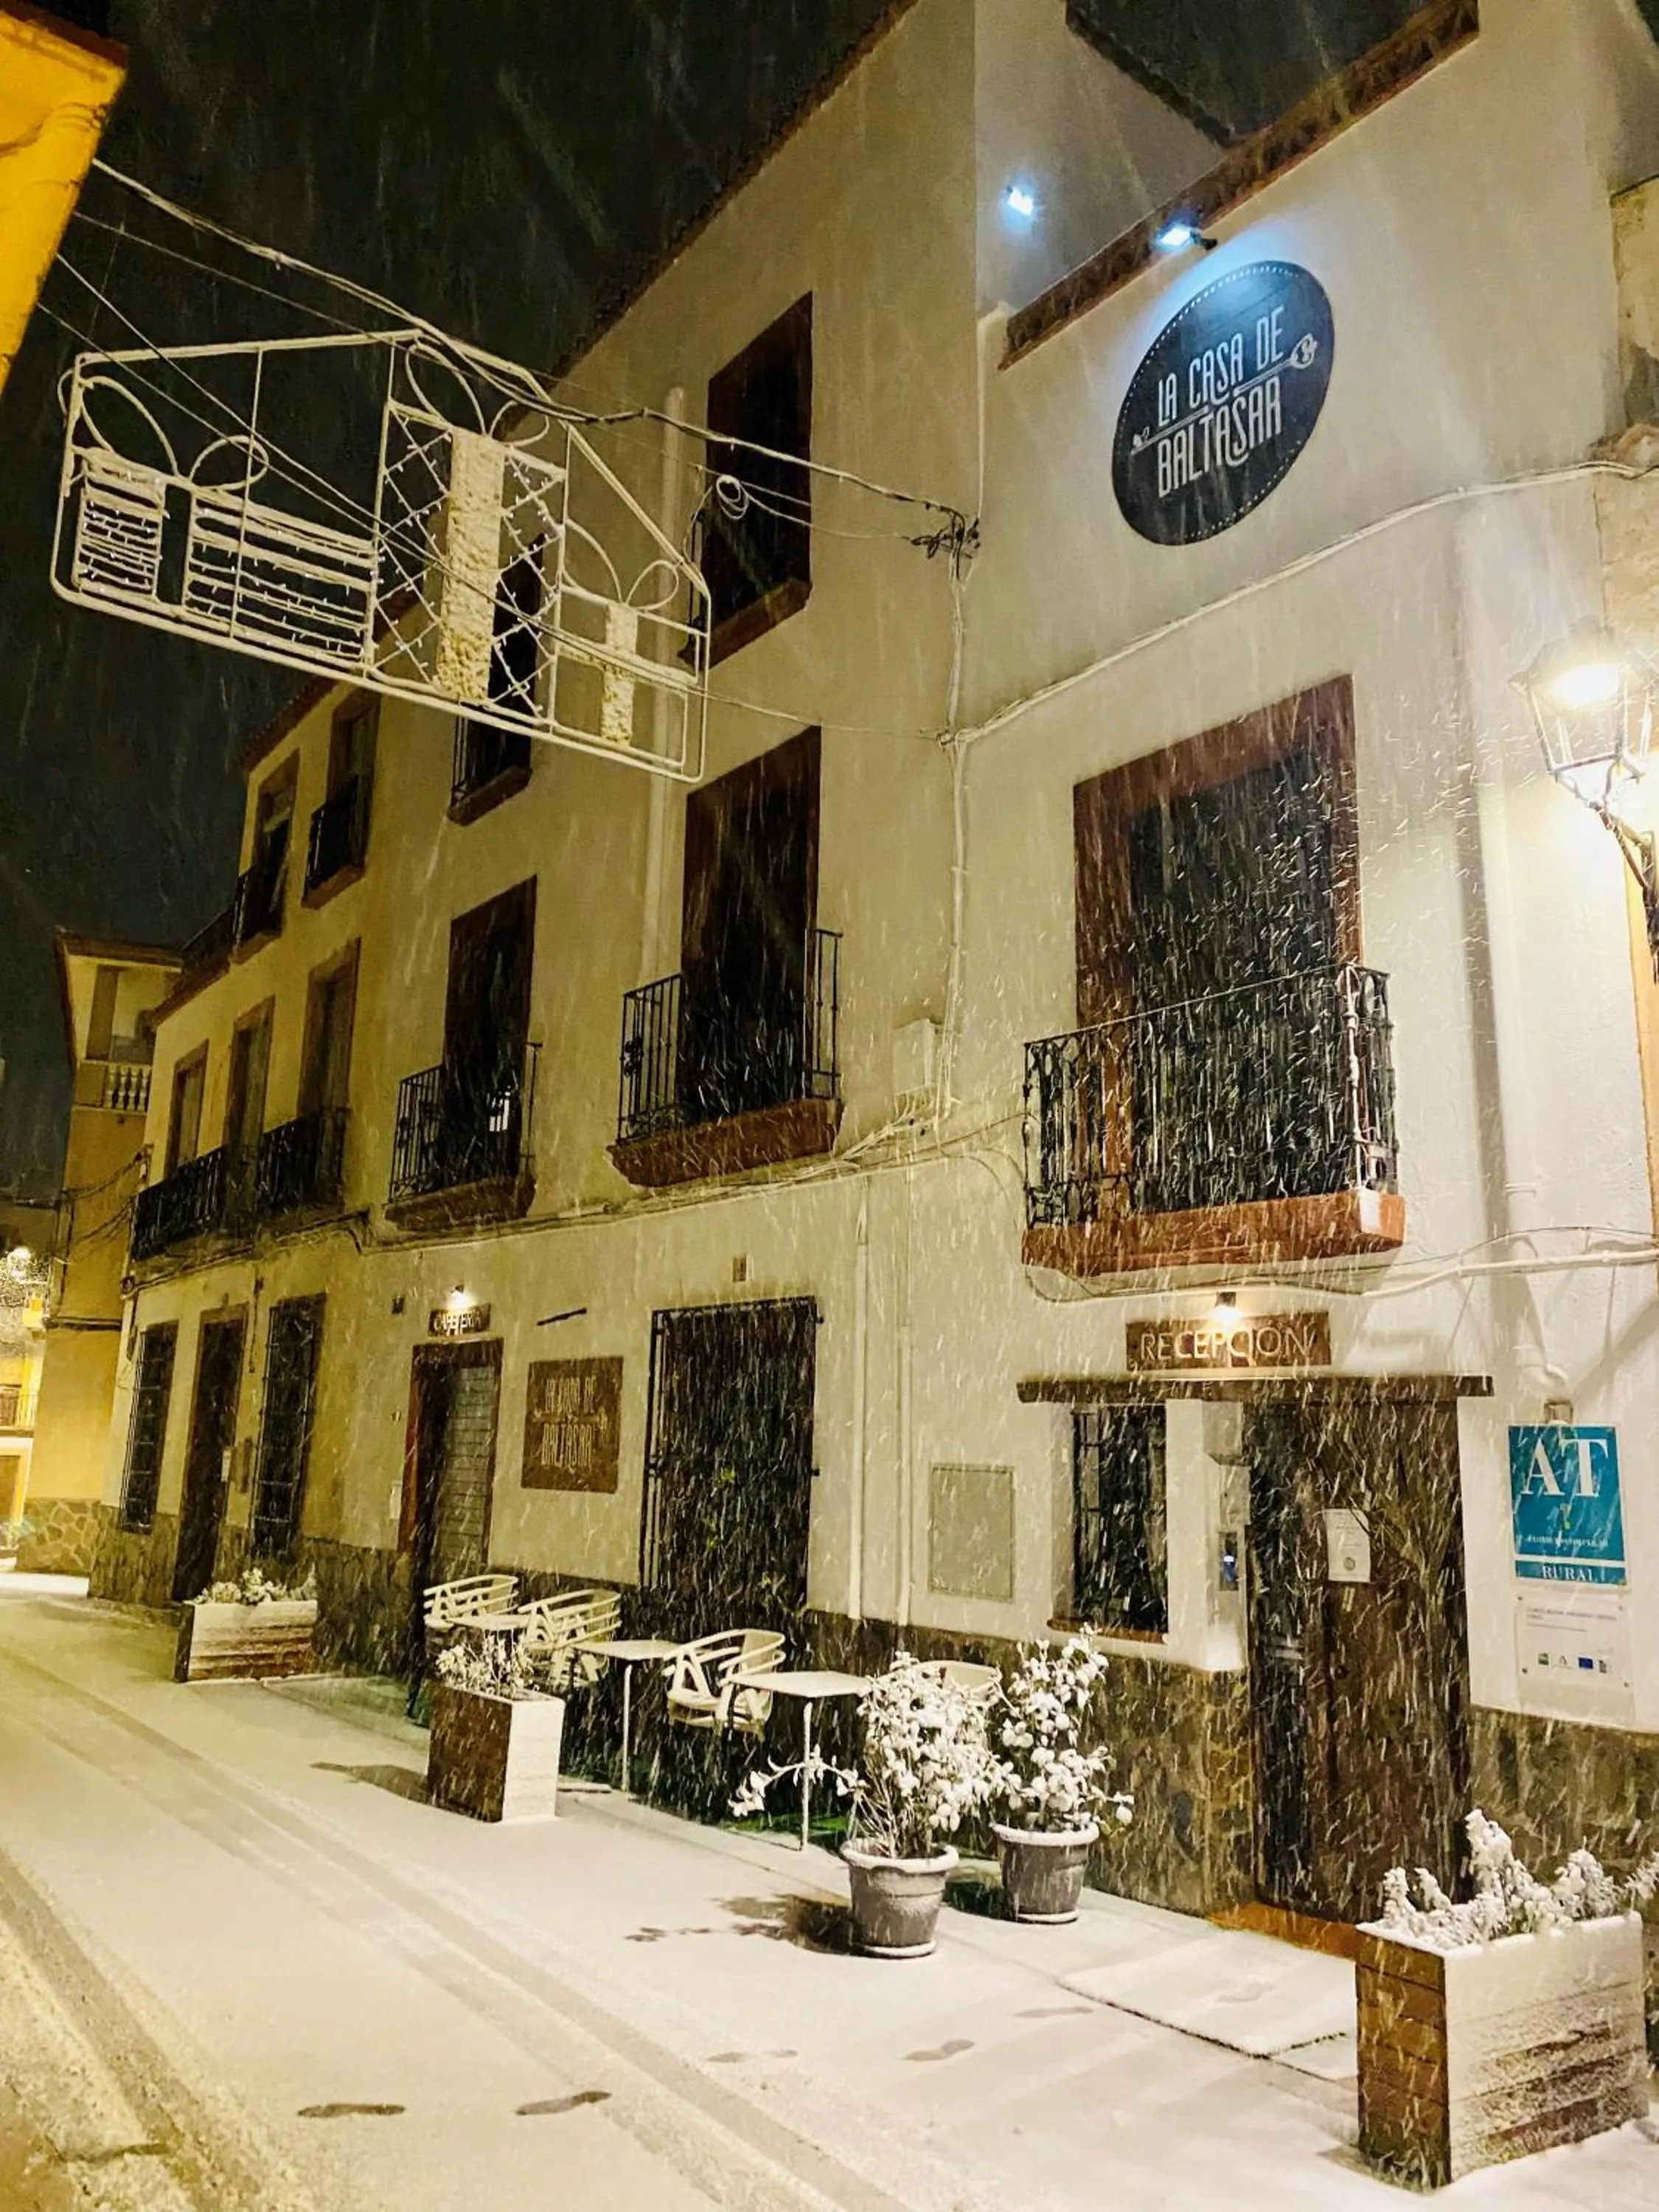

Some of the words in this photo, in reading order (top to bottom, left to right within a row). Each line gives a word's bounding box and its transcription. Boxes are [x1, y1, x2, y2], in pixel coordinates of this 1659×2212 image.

[1158, 372, 1178, 427] LA
[1189, 333, 1243, 409] CASA
[1256, 306, 1284, 369] DE
[1158, 375, 1281, 498] BALTASAR
[1520, 1436, 1609, 1499] AT
[1542, 1565, 1598, 1582] RURAL
